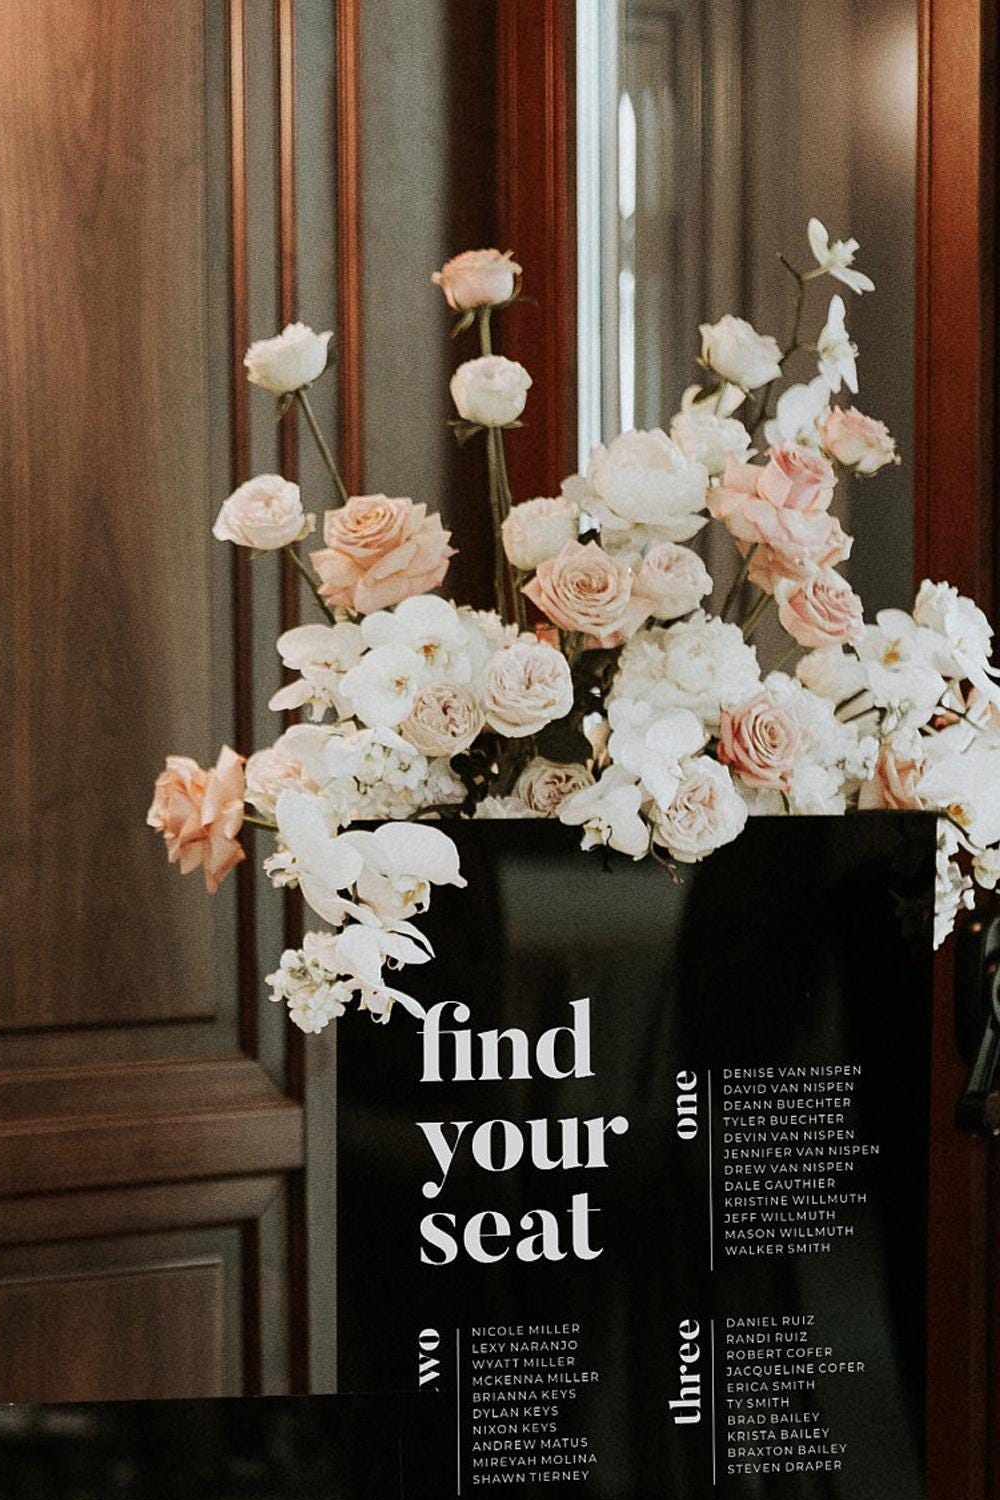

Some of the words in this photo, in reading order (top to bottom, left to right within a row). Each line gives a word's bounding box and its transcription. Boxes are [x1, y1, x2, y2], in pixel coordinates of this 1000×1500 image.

[416, 997, 595, 1082] find
[723, 1067, 774, 1079] DENISE
[778, 1067, 806, 1077] VAN
[810, 1065, 861, 1076] NISPEN
[723, 1084, 767, 1095] DAVID
[770, 1083, 798, 1093] VAN
[803, 1082, 854, 1092] NISPEN
[676, 1071, 698, 1139] one
[723, 1100, 772, 1111] DEANN
[777, 1097, 851, 1110] BUECHTER
[722, 1115, 766, 1127] TYLER
[770, 1113, 844, 1126] BUECHTER
[724, 1132, 767, 1143] DEVIN
[770, 1131, 799, 1141] VAN
[803, 1130, 854, 1141] NISPEN
[416, 1116, 628, 1198] your
[723, 1147, 792, 1159] JENNIFER
[796, 1147, 824, 1156] VAN
[828, 1144, 879, 1156] NISPEN
[724, 1164, 766, 1175] DREW
[770, 1163, 798, 1174] VAN
[803, 1161, 853, 1172] NISPEN
[725, 1180, 760, 1192] DALE
[764, 1178, 836, 1190] GAUTHIER
[725, 1195, 788, 1207] KRISTINE
[792, 1193, 867, 1205] WILLMUTH
[724, 1212, 757, 1223] JEFF
[761, 1210, 835, 1222] WILLMUTH
[420, 1193, 603, 1265] seat
[725, 1228, 775, 1240] MASON
[779, 1226, 854, 1238] WILLMUTH
[725, 1244, 784, 1256] WALKER
[787, 1243, 830, 1254] SMITH
[419, 1329, 440, 1391] wo
[669, 1320, 700, 1424] three
